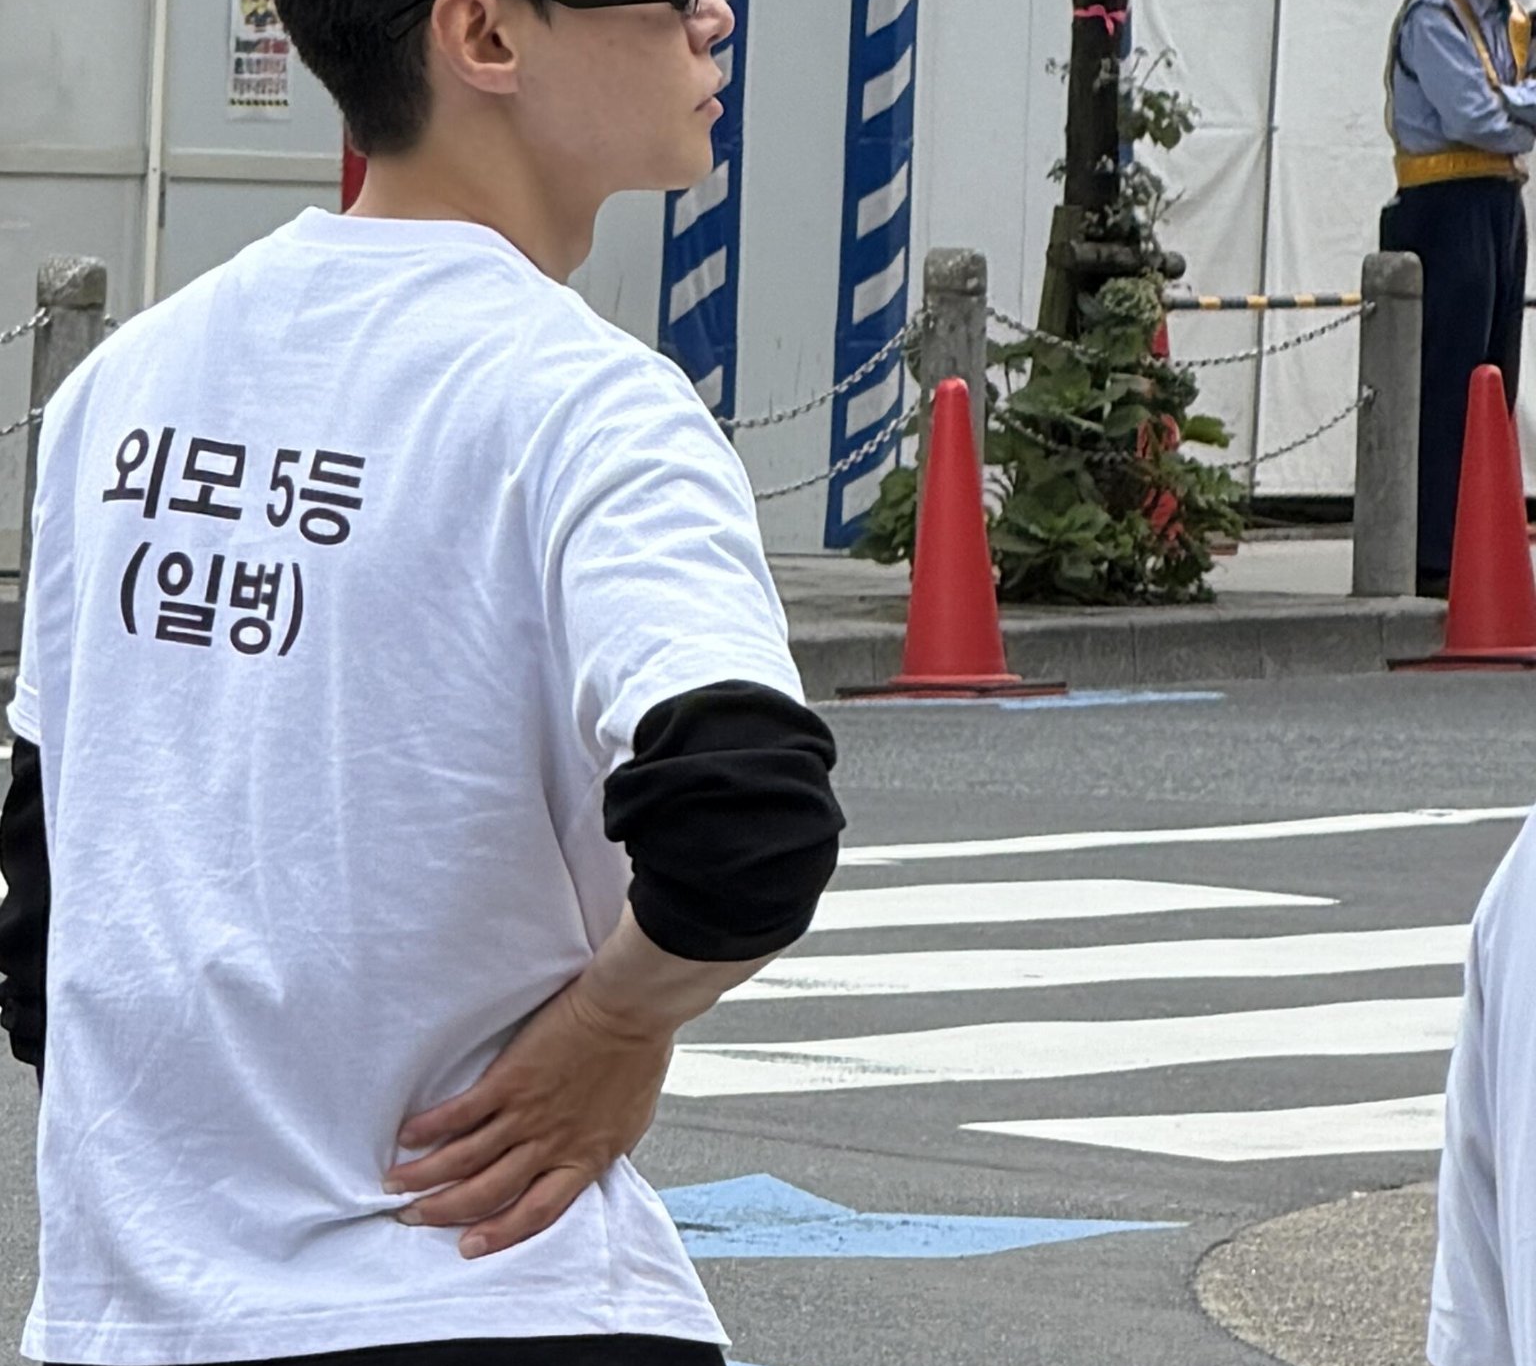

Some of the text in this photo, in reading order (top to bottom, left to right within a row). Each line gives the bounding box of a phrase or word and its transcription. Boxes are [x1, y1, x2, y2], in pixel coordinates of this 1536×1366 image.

[101, 426, 367, 547] 외모 5등
[120, 541, 304, 657] (일병)
